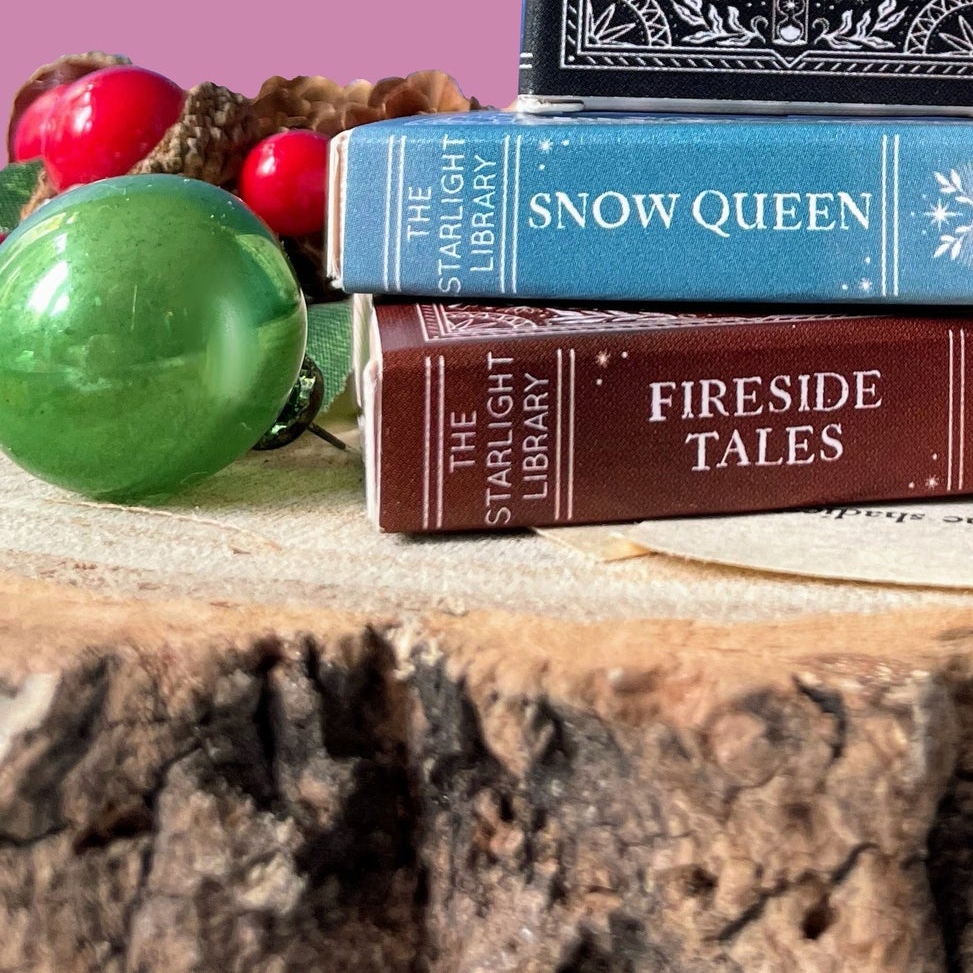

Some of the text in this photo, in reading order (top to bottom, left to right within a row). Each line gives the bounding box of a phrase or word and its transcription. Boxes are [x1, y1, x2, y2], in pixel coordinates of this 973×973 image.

[406, 186, 432, 243] THE
[437, 133, 466, 293] STARLIGHT
[469, 154, 497, 272] LIBRARY
[528, 189, 873, 238] SNOW QUEEN
[649, 369, 882, 422] FIRESIDE
[449, 410, 477, 473] THE
[484, 351, 514, 525] STARLIGHT
[522, 372, 549, 500] LIBRARY
[685, 423, 843, 471] TALES
